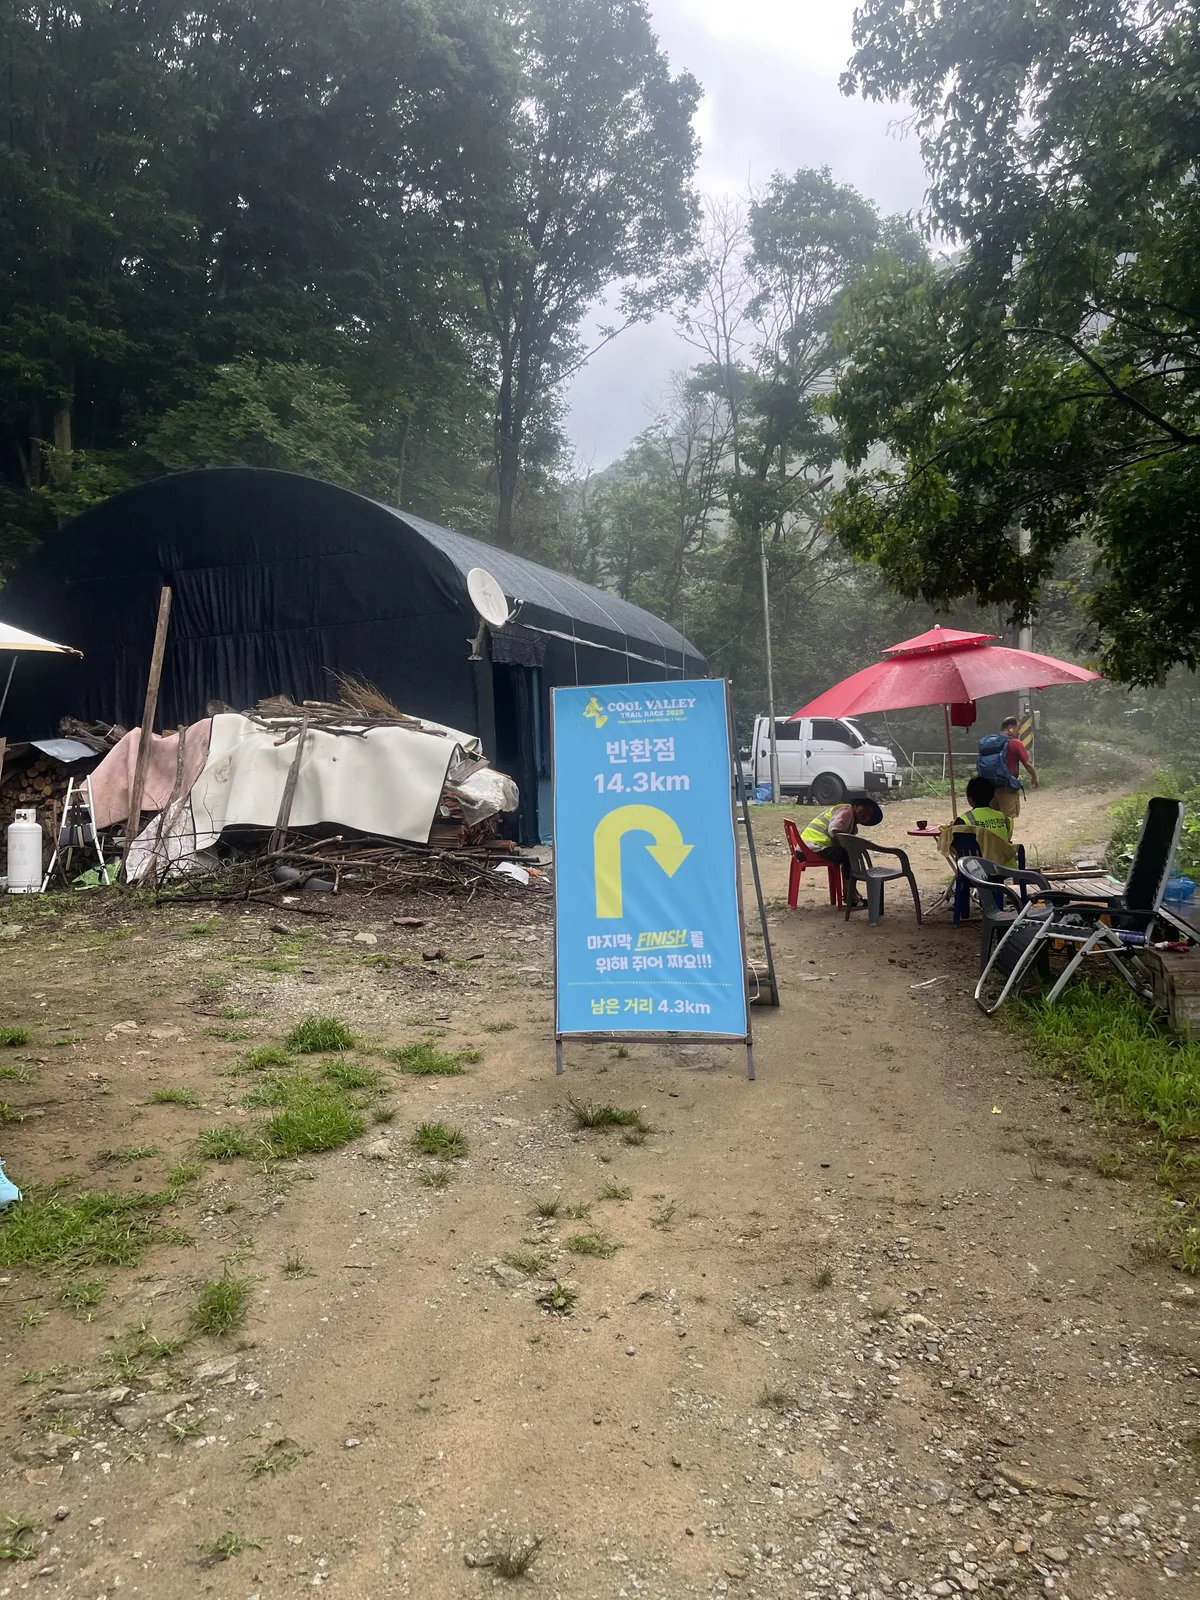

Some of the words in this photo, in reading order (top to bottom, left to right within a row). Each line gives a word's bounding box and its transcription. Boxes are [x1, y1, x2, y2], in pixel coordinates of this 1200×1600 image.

[607, 702, 642, 712] COOL
[645, 698, 696, 710] VALLEY
[607, 737, 675, 763] 반환점
[594, 771, 690, 793] 14.3km
[587, 934, 632, 950] 마지막
[636, 929, 688, 949] FINISH
[690, 930, 704, 948] 를
[596, 956, 629, 973] 위해
[632, 955, 663, 972] 쥐어
[666, 954, 712, 969] 짜요!!!
[591, 998, 620, 1015] 남은
[623, 997, 653, 1015] 거리
[657, 999, 711, 1014] 4.3km
